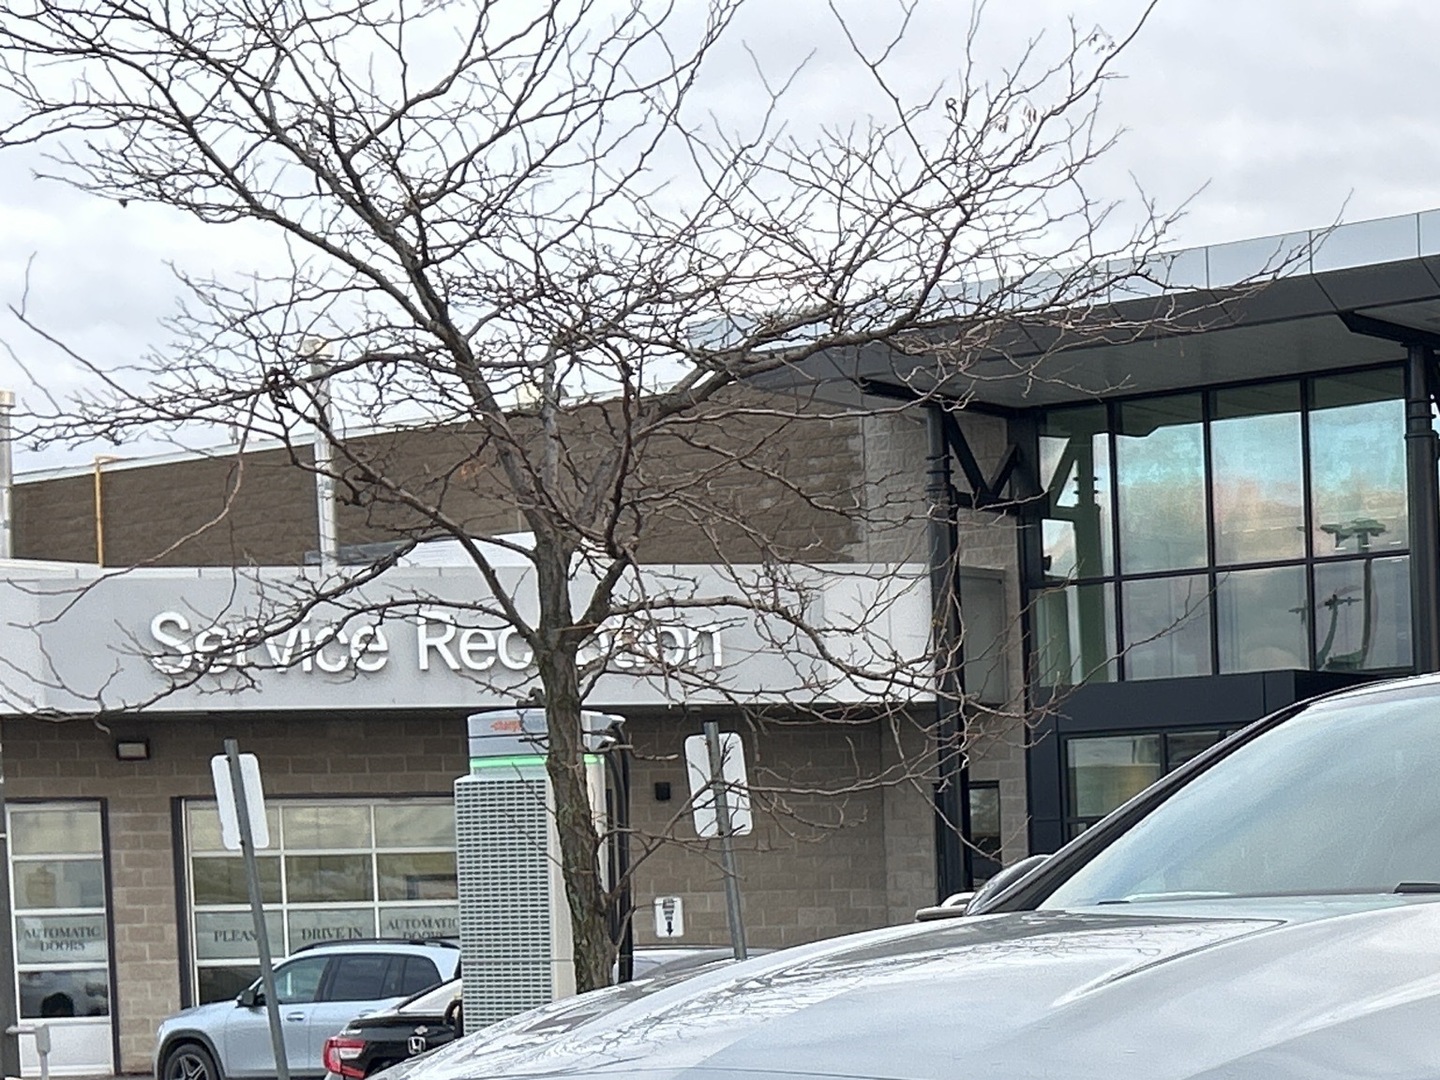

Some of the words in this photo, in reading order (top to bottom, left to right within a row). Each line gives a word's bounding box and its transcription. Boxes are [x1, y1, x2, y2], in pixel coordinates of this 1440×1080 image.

[151, 611, 388, 674] Service
[416, 609, 722, 673] Recption
[24, 926, 101, 940] AUTOMATIC
[213, 929, 259, 943] PLEAS
[301, 927, 345, 941] DRIVE
[348, 926, 364, 939] IN
[39, 940, 86, 953] DOORS
